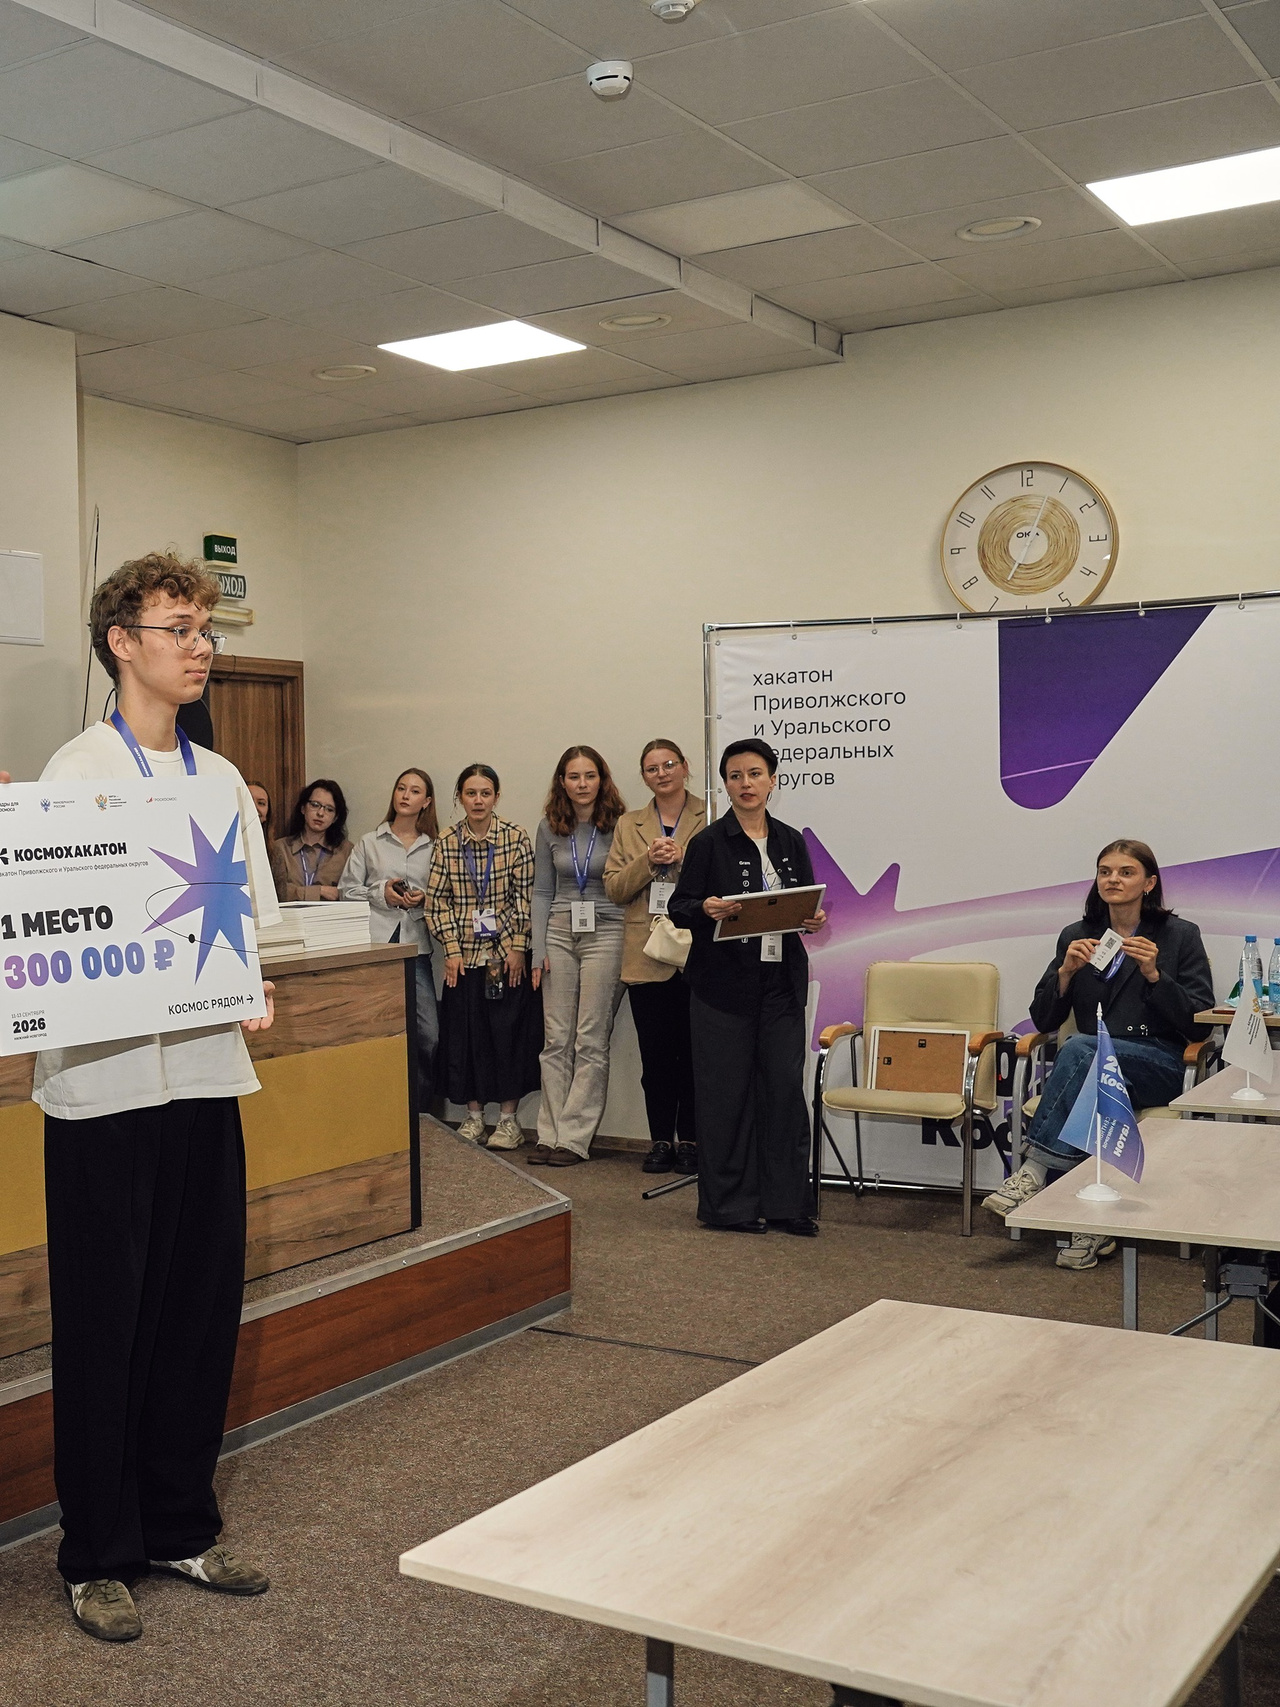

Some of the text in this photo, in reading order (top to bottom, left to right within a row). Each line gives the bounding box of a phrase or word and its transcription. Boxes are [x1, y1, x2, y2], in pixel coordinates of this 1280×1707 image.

[1021, 469, 1034, 487] 12
[214, 544, 236, 556] ВЫХОД
[218, 575, 245, 597] ЫХОД
[753, 669, 833, 687] хакатон
[753, 691, 907, 714] Приволжского
[753, 718, 891, 739] и Уральского
[772, 744, 894, 764] едеральных
[778, 772, 835, 790] ругов
[14, 842, 128, 862] КОСМОХАКАТОН
[18, 867, 58, 877] Приволжского
[64, 865, 93, 874] Уральского
[94, 862, 128, 871] федеральных
[129, 860, 149, 869] округов
[0, 905, 114, 940] 1 МЕСТО
[4, 950, 72, 990] 300
[81, 942, 146, 980] 000
[168, 995, 244, 1015] КОСМОС РЯДОМ
[13, 1017, 46, 1033] 2026
